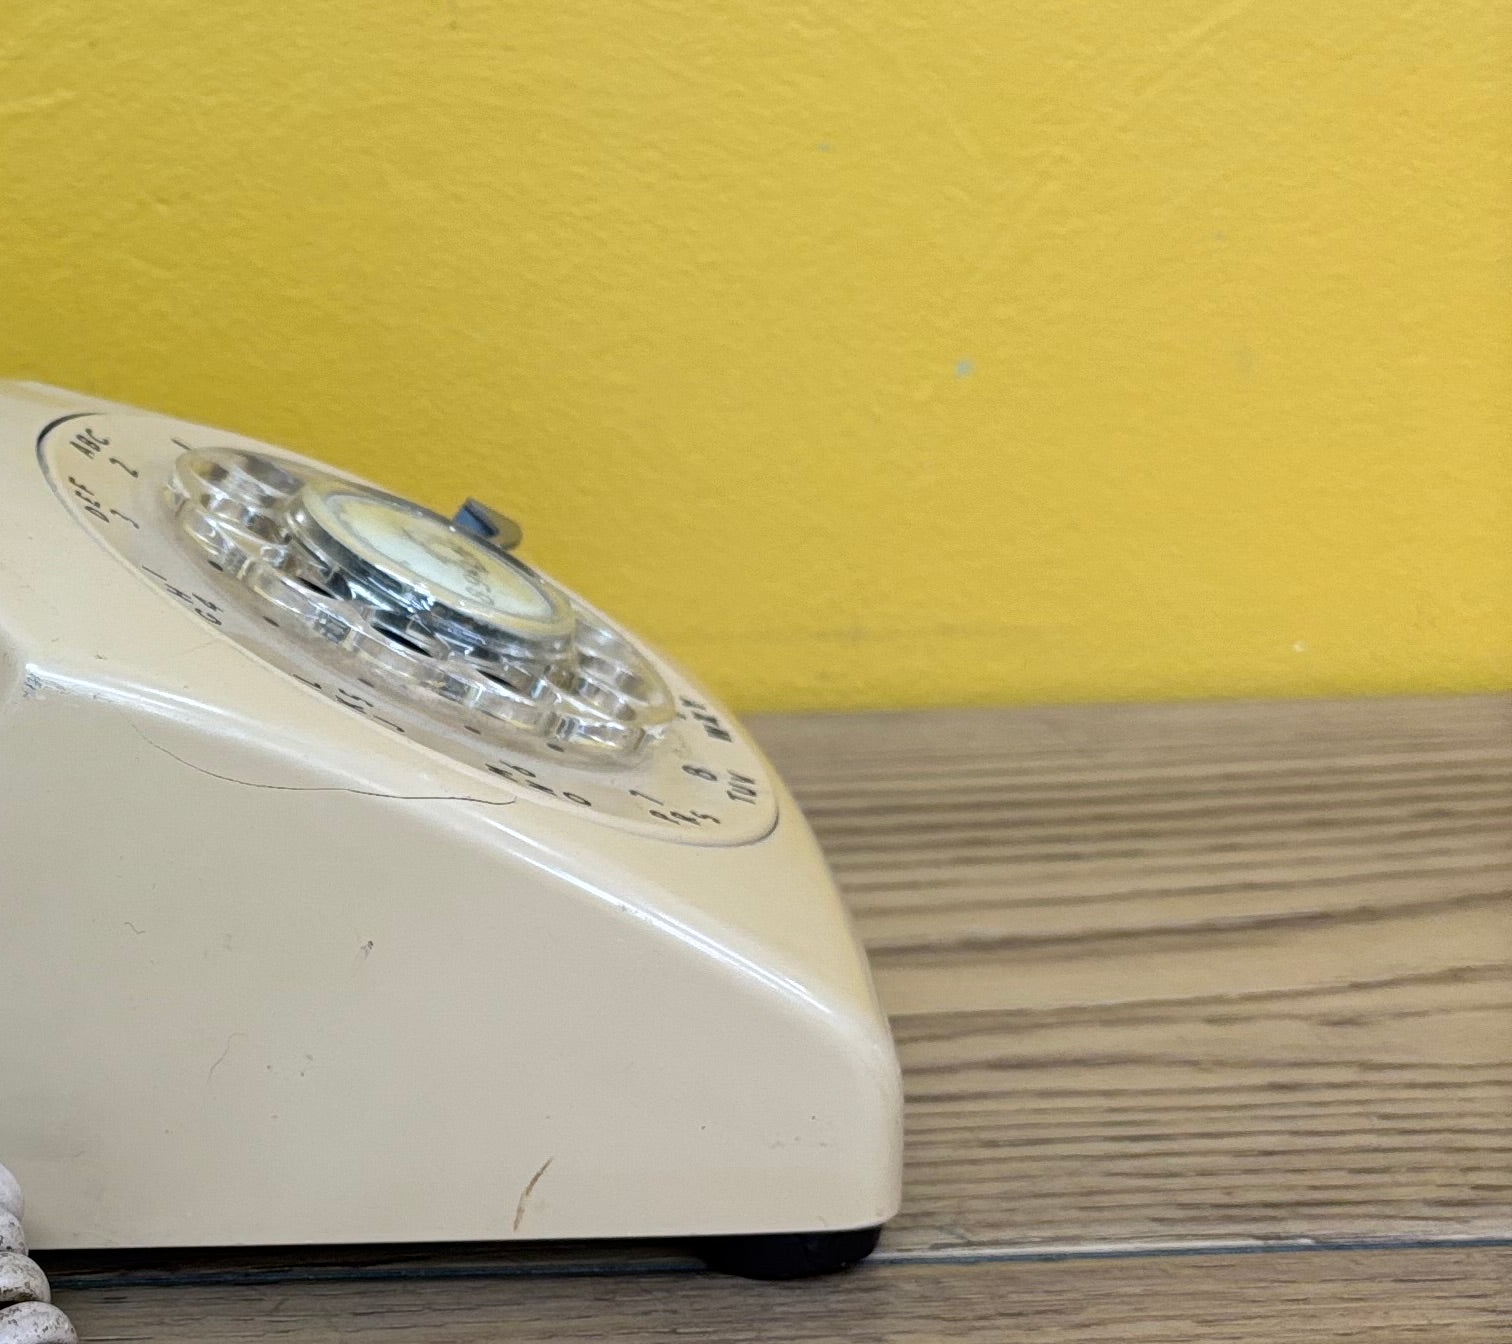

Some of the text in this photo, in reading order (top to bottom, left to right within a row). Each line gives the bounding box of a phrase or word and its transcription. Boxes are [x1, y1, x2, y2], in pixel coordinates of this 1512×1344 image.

[69, 428, 110, 459] ABC
[109, 457, 139, 478] 2
[68, 476, 110, 523] DEF
[110, 509, 140, 529] 3
[191, 592, 224, 612] 4
[338, 688, 373, 707] 5
[499, 760, 536, 777] 6
[681, 764, 717, 782] 8
[727, 769, 757, 805] TUV
[629, 789, 664, 806] 7
[649, 809, 721, 826] PRS
